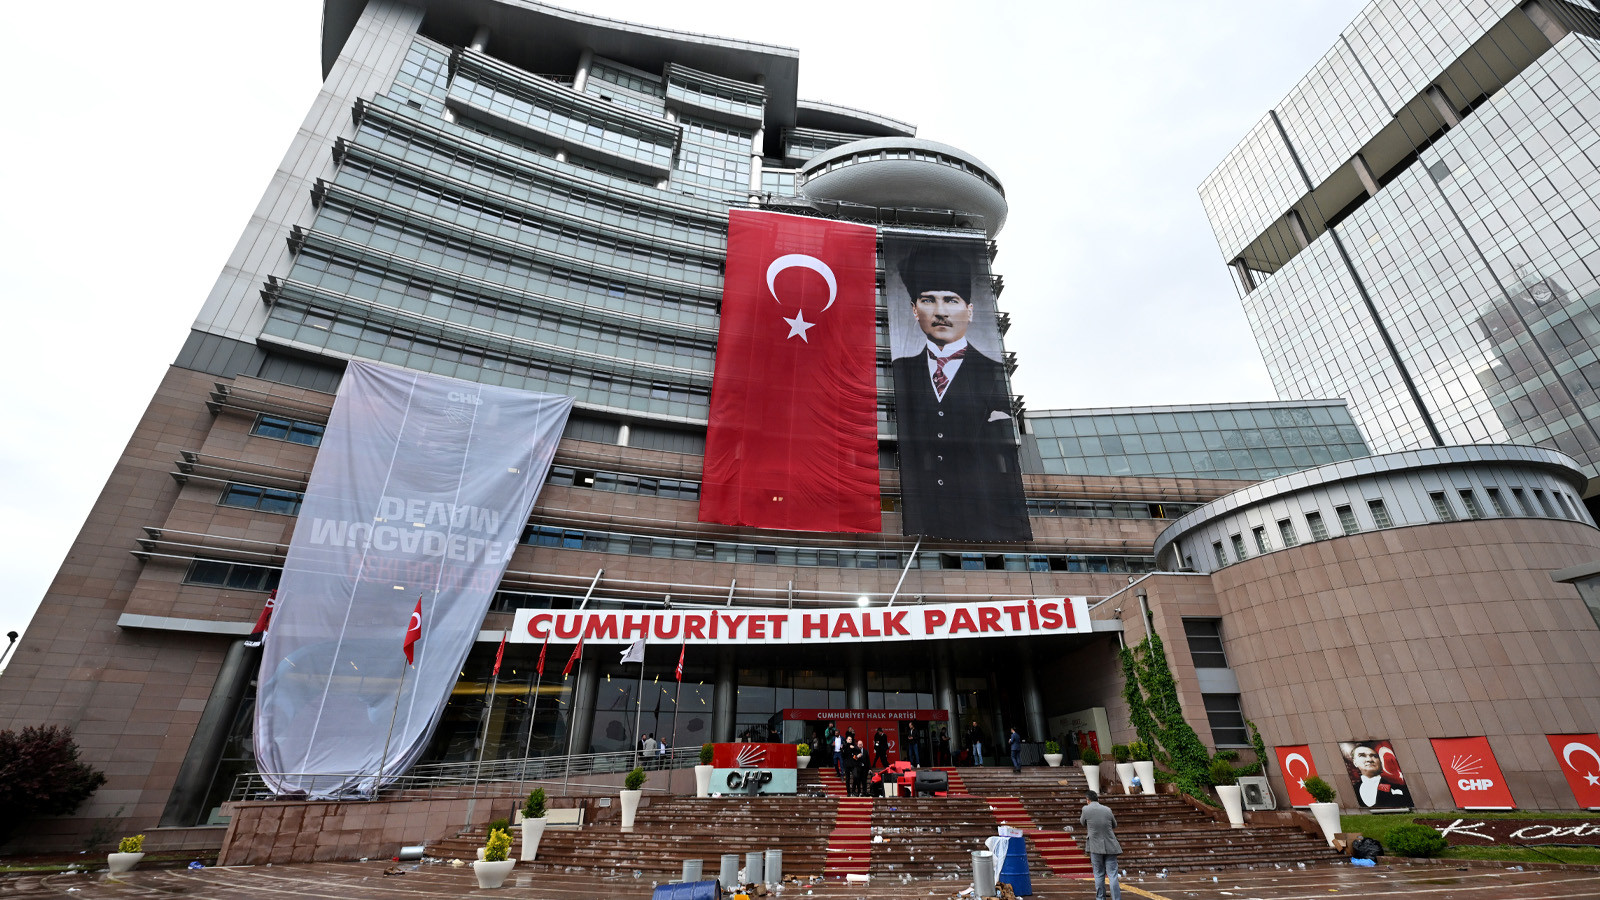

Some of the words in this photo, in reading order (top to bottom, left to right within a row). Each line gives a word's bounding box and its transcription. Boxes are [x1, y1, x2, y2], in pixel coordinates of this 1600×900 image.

[527, 610, 788, 639] CUMHURİYET
[802, 610, 910, 638] HALK
[924, 597, 1076, 635] PARTİSİ
[817, 710, 865, 719] CUMHURİYET
[889, 711, 917, 719] PARTİSİ
[726, 770, 773, 790] CHP
[1457, 778, 1494, 791] CHP
